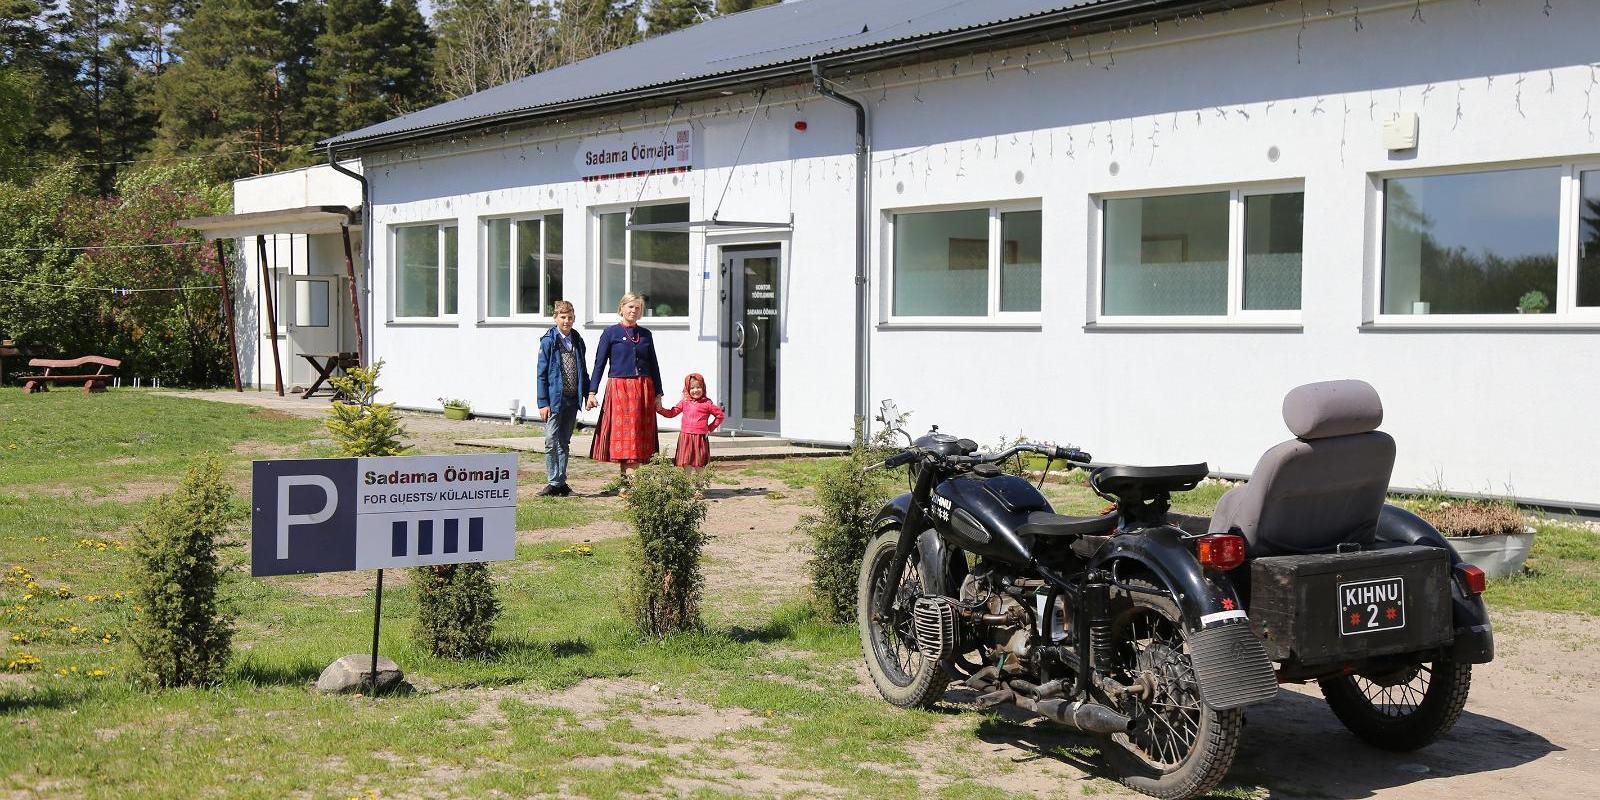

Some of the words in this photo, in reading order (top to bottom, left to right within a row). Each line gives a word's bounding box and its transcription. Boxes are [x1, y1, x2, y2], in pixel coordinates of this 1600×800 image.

[585, 150, 628, 166] Sadama
[631, 142, 675, 161] Öömaja
[364, 471, 438, 486] Sadama
[444, 465, 510, 484] Öömaja
[363, 494, 387, 505] FOR
[439, 489, 510, 501] KÜLALISTELE
[276, 474, 339, 560] P
[1345, 583, 1398, 606] KIHNU
[1366, 604, 1379, 628] 2
